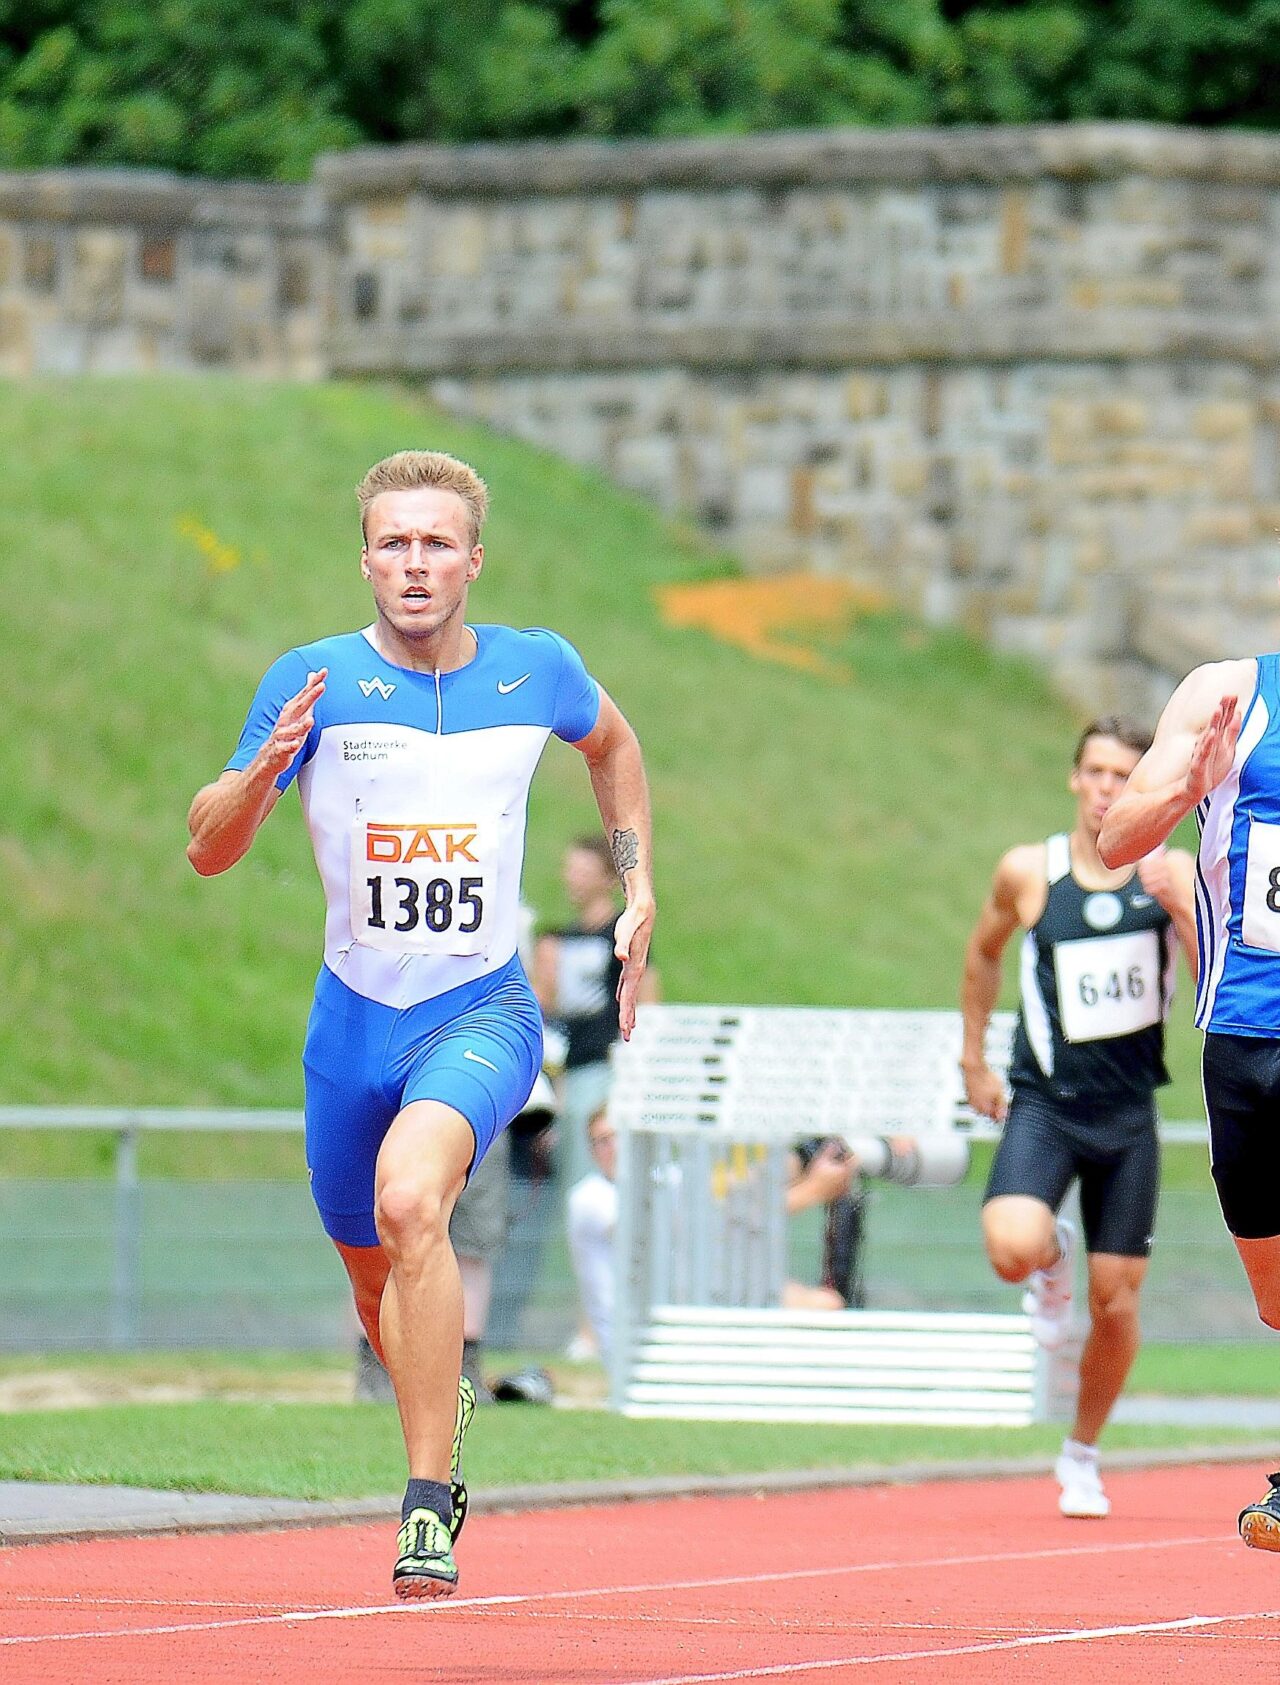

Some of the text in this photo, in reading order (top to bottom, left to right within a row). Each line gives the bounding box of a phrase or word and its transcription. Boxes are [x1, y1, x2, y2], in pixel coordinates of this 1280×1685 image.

[343, 740, 408, 750] Stadtwerke
[343, 752, 388, 761] Bochum
[366, 822, 479, 863] DAK
[366, 875, 483, 932] 1385
[1079, 964, 1145, 1007] 646
